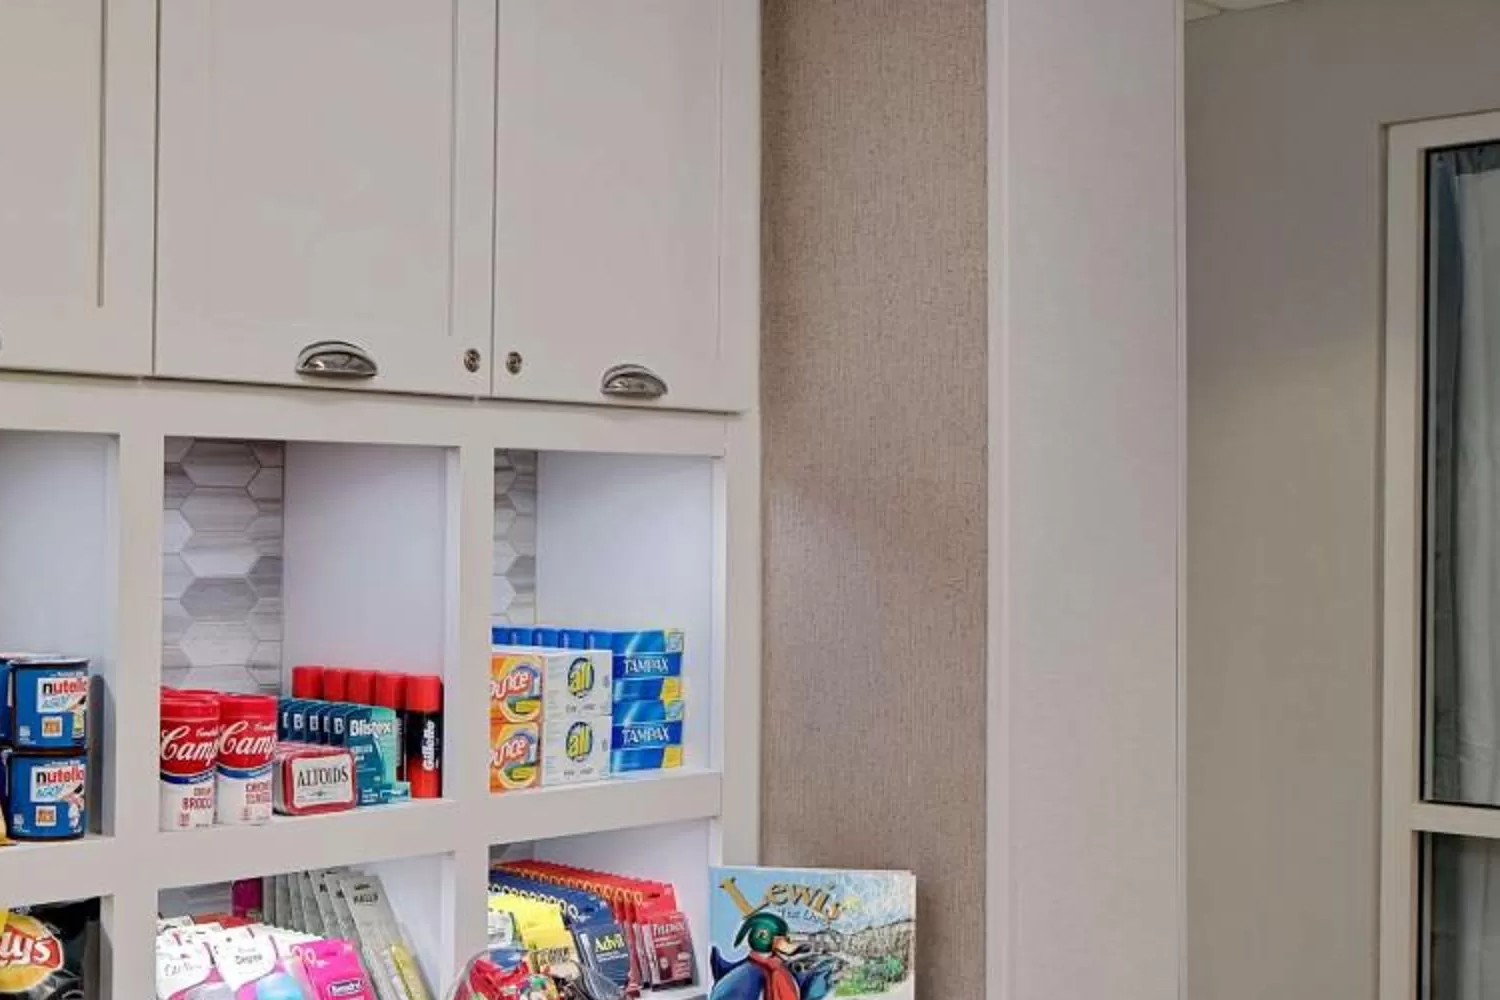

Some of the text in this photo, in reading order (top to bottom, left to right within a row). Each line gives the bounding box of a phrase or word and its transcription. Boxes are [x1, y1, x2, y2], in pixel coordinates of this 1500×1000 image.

[568, 661, 593, 693] all
[623, 659, 669, 675] TAMPAX
[350, 718, 391, 738] Blistex
[621, 726, 669, 745] TAMPAX
[421, 719, 436, 771] Gillette
[566, 727, 591, 758] all
[298, 766, 349, 787] ALTOIDS
[595, 933, 625, 953] Advil
